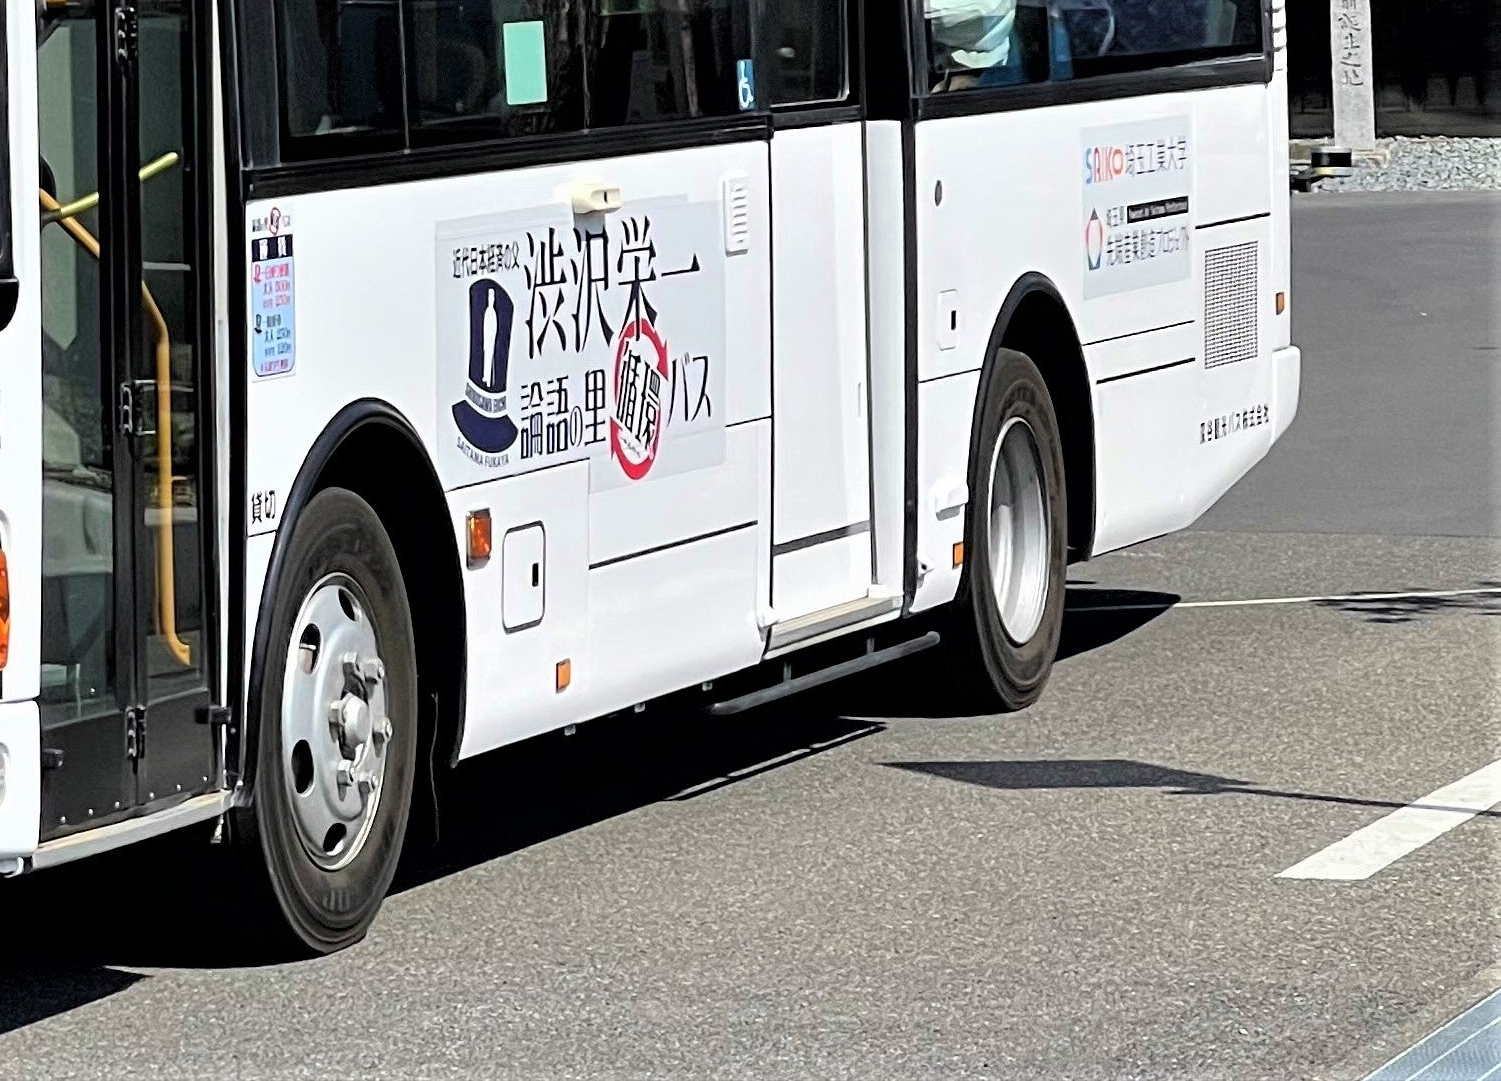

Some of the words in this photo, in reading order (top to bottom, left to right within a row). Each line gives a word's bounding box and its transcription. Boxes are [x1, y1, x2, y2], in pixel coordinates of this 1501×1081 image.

[1085, 146, 1124, 184] SAIKO
[523, 215, 701, 360] 渋沢栄一
